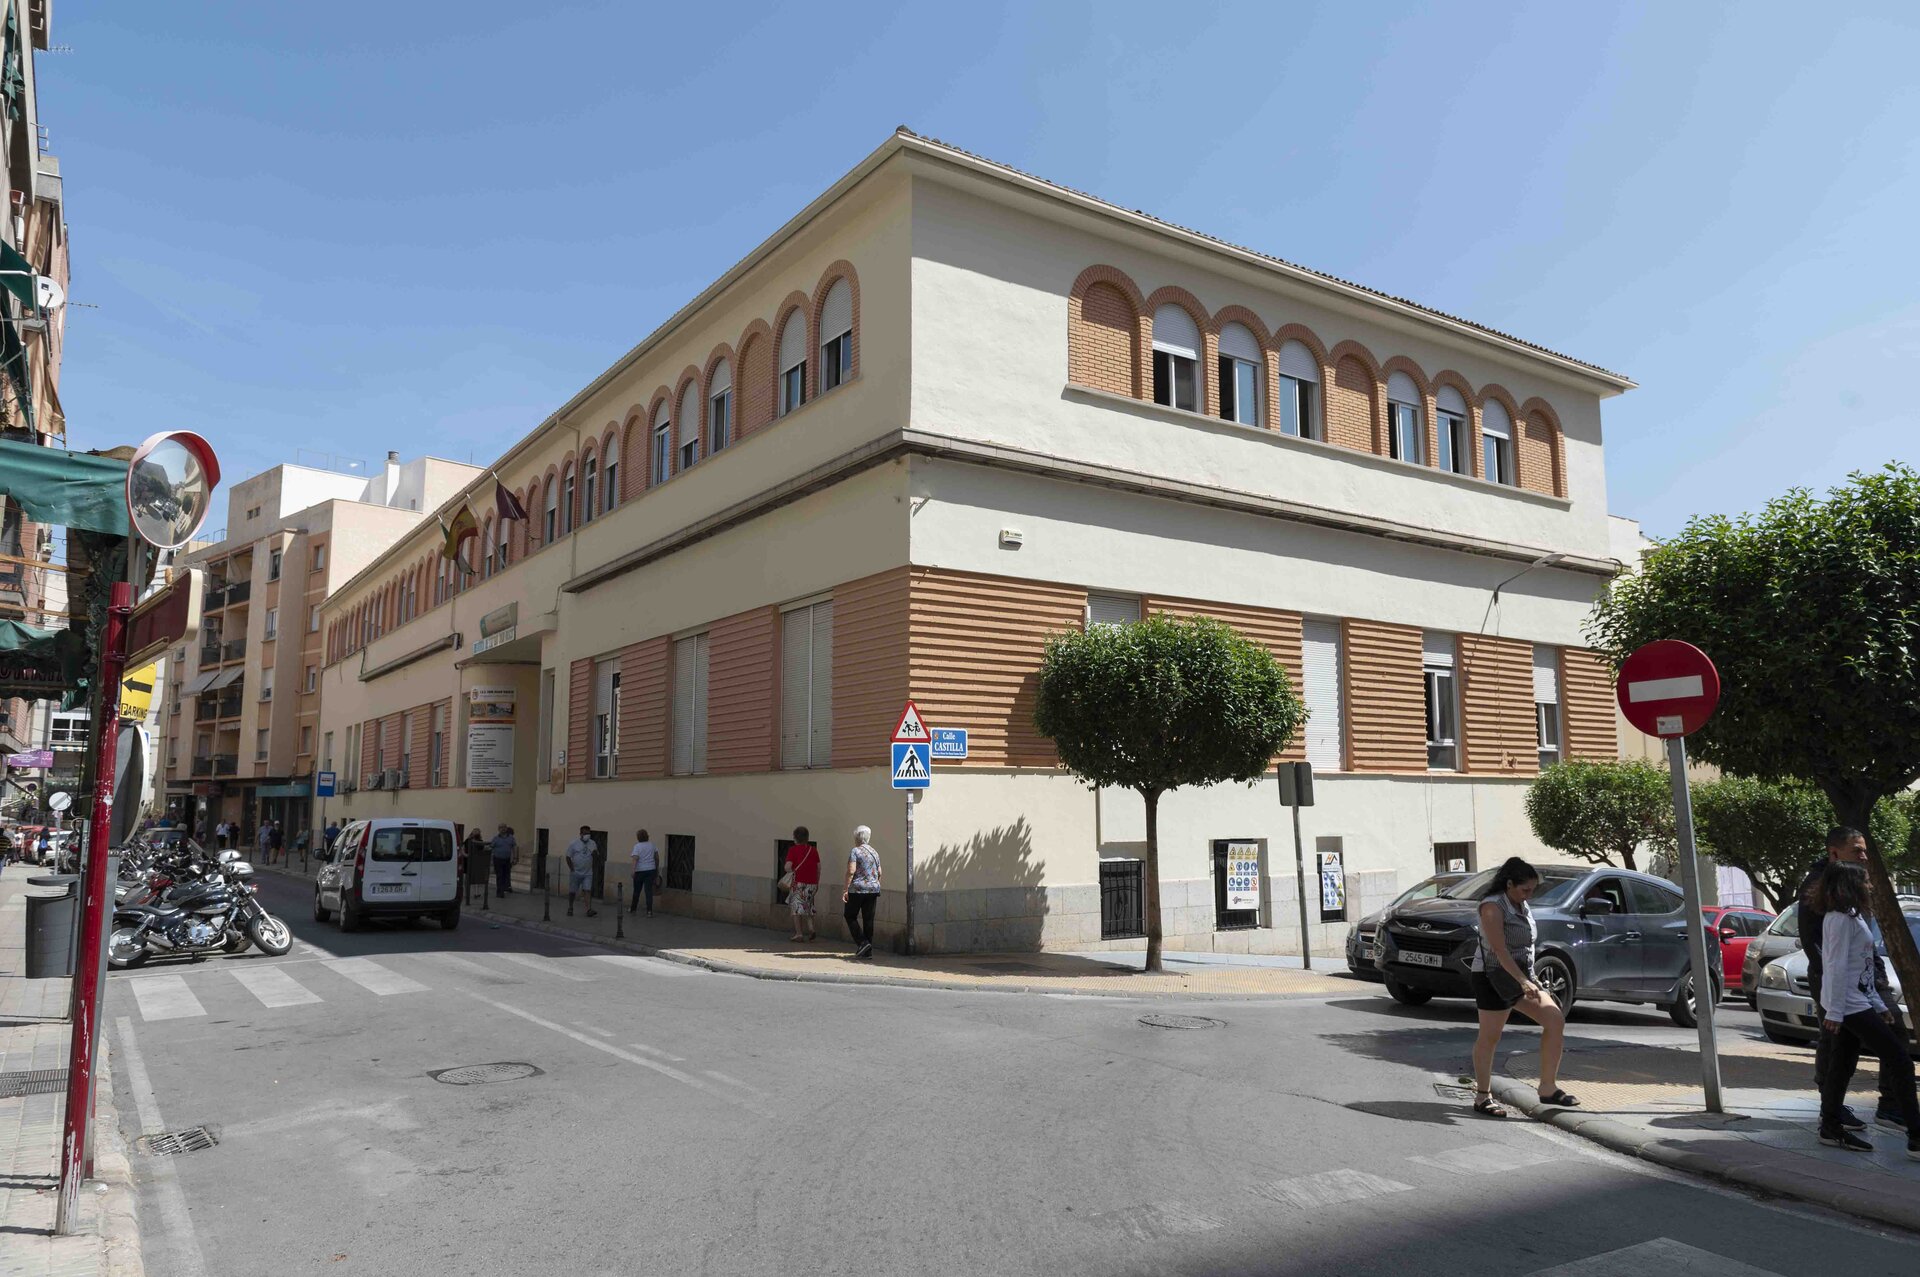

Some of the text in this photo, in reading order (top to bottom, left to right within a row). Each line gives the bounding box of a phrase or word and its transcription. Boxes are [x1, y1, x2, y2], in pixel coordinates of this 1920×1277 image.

[121, 703, 148, 719] PARKING
[942, 731, 956, 740] Calle
[934, 742, 964, 751] CASTILLA
[1405, 952, 1422, 963] 2545
